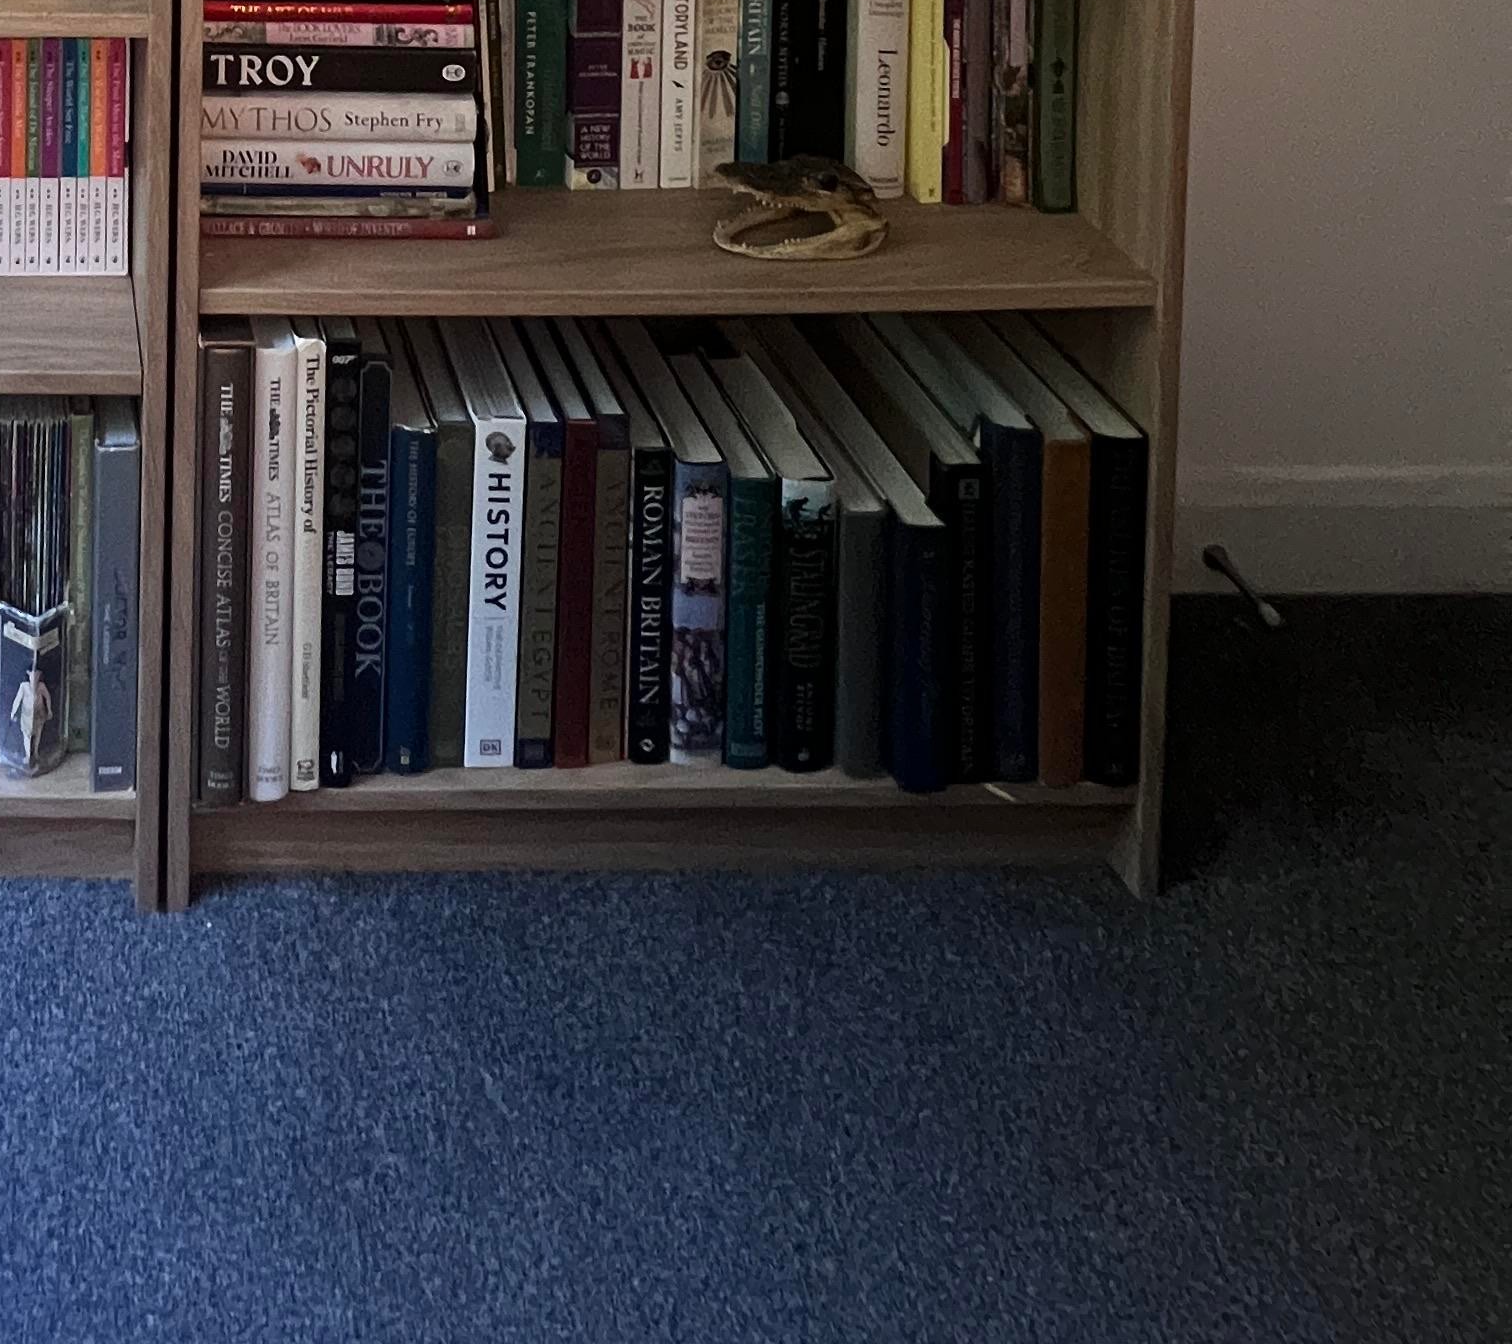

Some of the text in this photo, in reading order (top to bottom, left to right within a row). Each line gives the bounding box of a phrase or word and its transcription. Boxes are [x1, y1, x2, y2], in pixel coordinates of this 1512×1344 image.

[211, 55, 319, 85] TROY
[877, 50, 896, 147] Leonardo
[201, 108, 443, 133] MYTHOS Stephen Fry
[222, 151, 277, 162] DAVID
[327, 156, 434, 178] UNRULY
[205, 166, 292, 178] MITCHELL
[485, 473, 510, 611] HISTORY
[356, 461, 385, 678] THE BOOK
[639, 486, 664, 704] ROMAN BRITAIN
